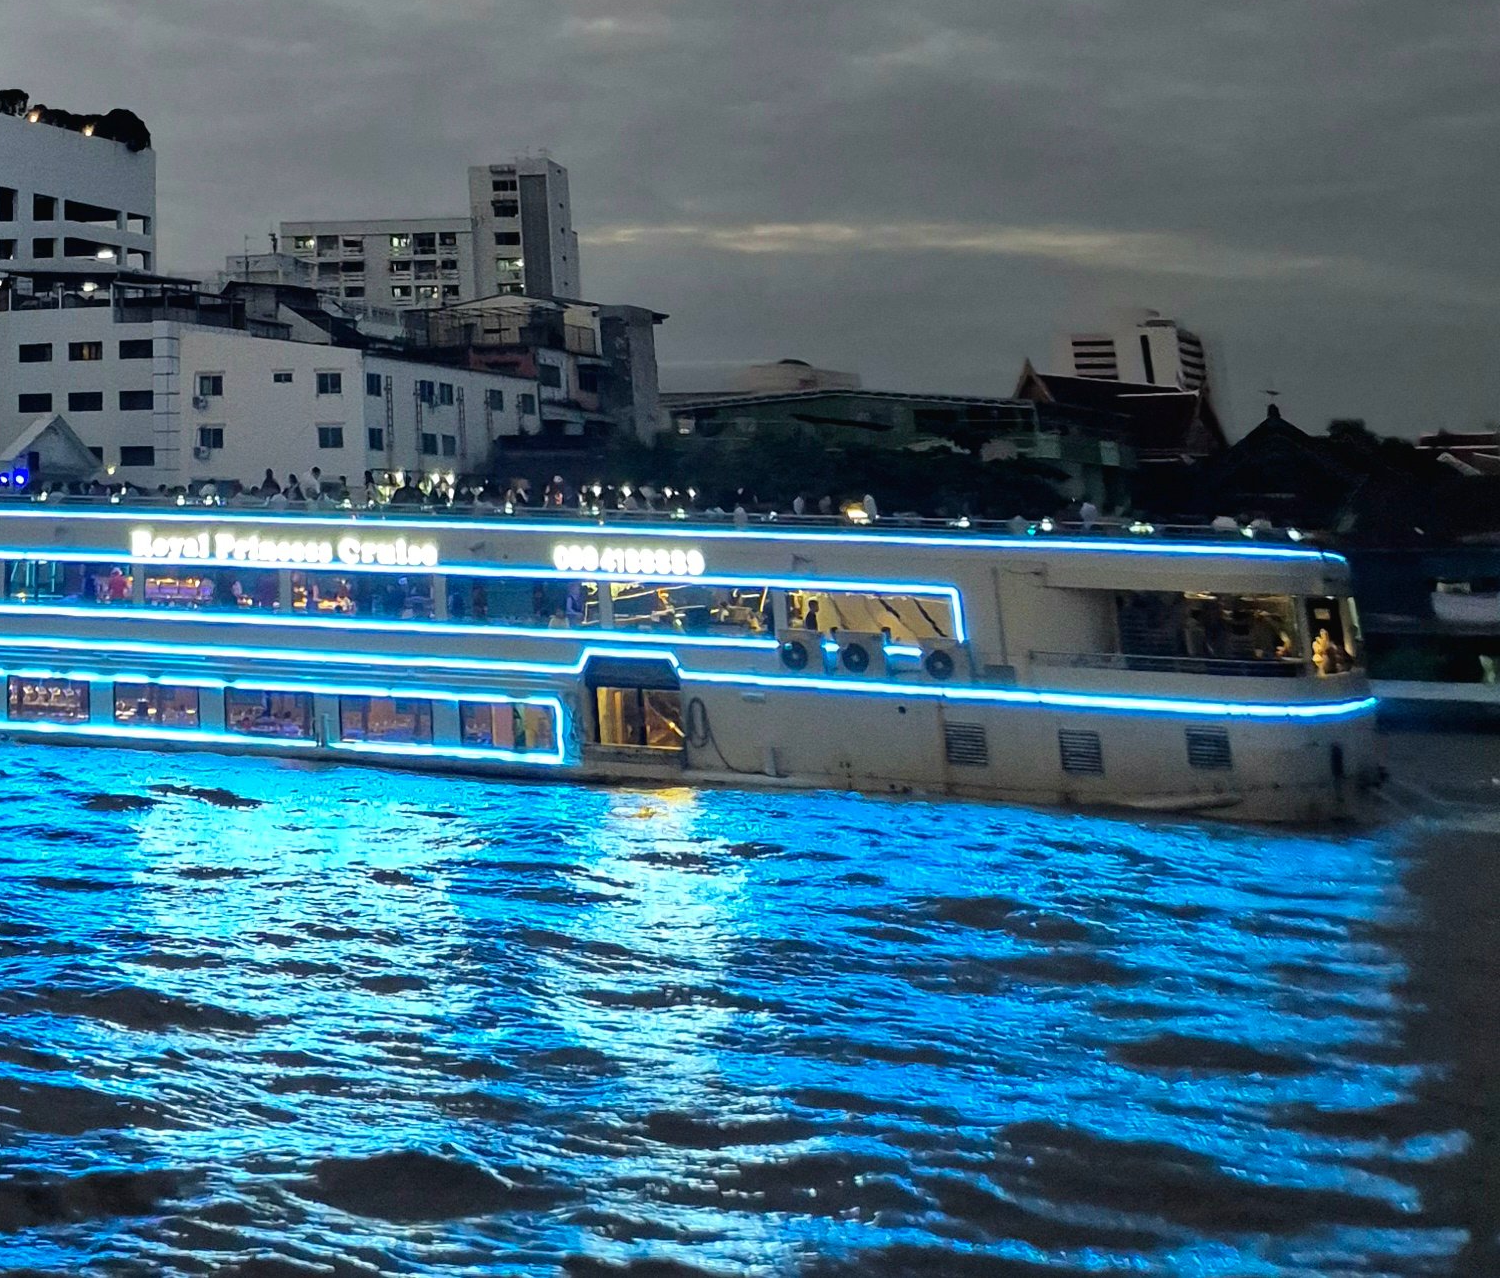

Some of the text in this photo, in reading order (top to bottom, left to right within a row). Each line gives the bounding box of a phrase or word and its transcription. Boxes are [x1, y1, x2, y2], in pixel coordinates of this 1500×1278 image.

[131, 529, 438, 567] Royal Princess Cruise
